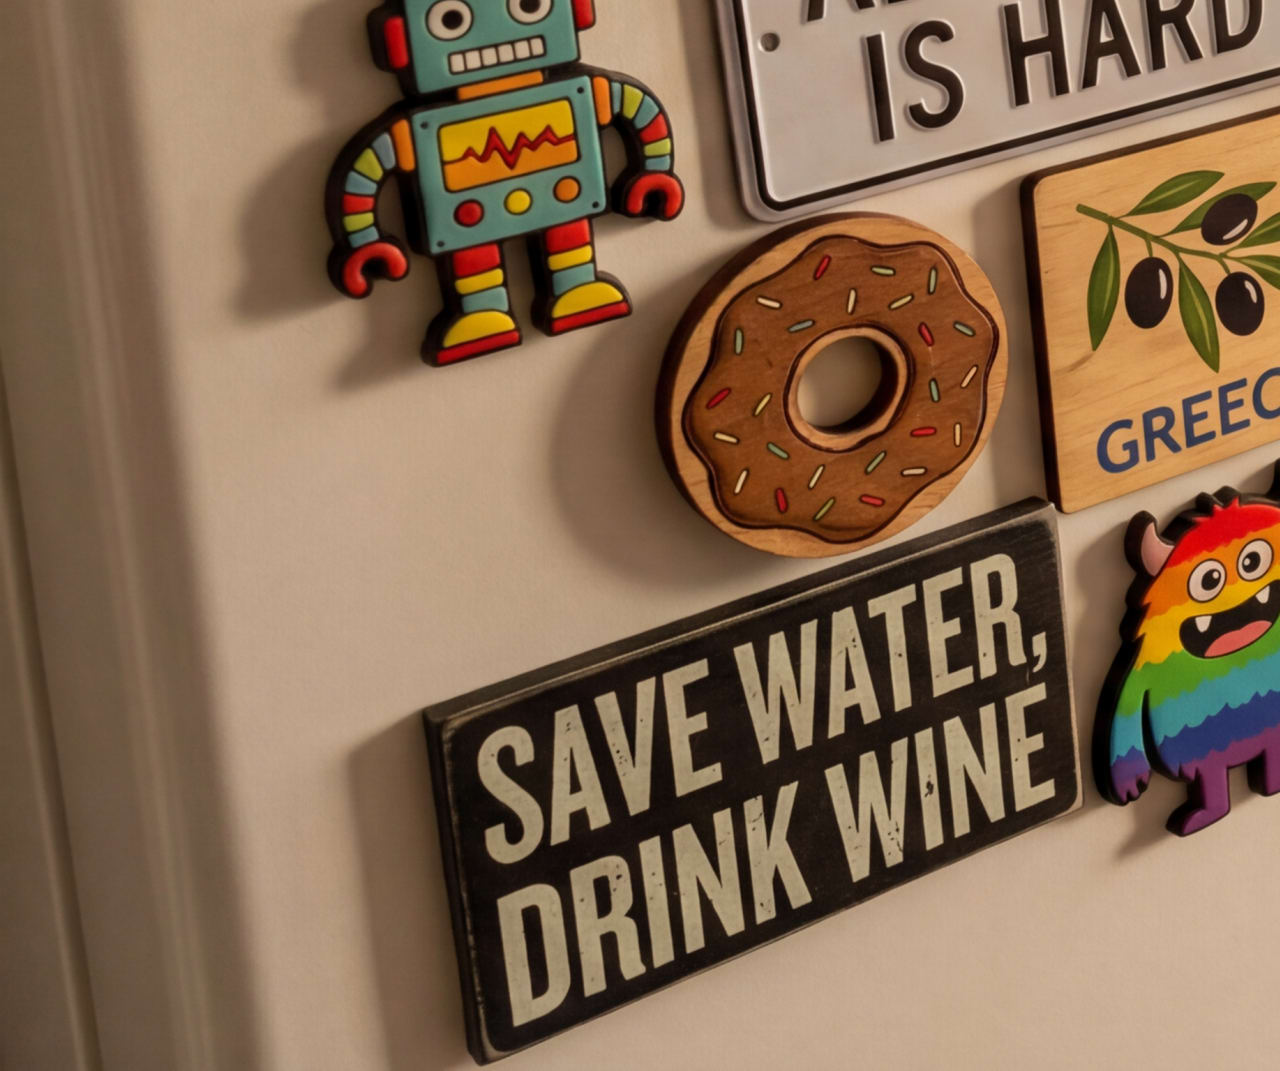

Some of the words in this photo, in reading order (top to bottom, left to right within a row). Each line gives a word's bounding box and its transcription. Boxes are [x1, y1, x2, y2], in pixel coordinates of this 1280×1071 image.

[865, 19, 964, 142] IS
[476, 658, 722, 865] SAVE
[733, 553, 1048, 765] WATER,
[497, 780, 812, 1027] DRINK
[824, 683, 1056, 883] WINE
